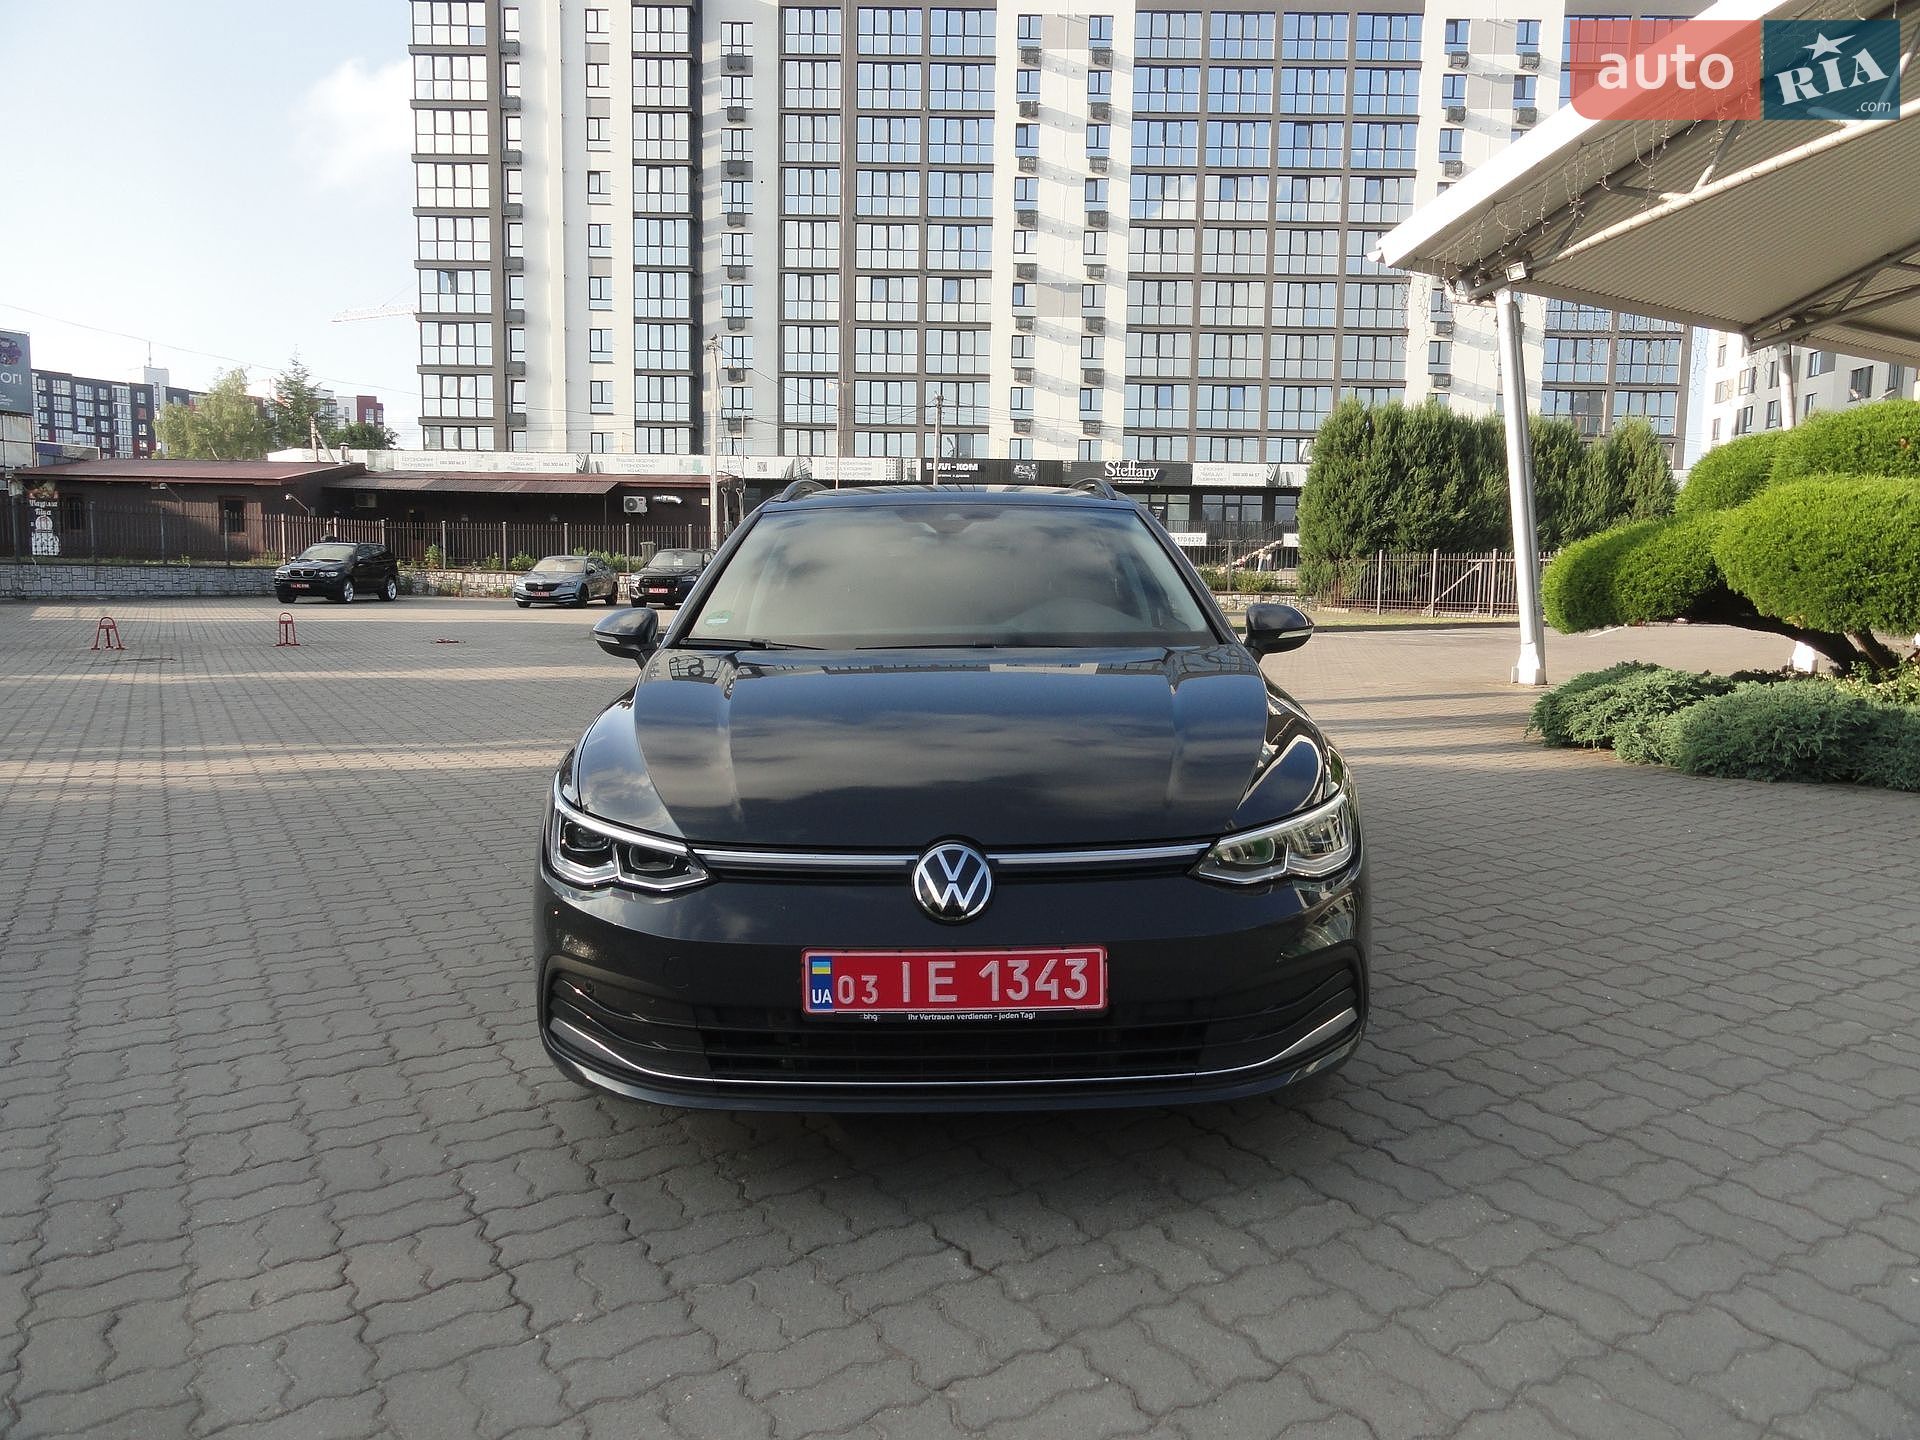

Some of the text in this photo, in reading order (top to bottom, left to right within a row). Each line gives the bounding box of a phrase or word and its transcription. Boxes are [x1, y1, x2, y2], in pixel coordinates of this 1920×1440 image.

[926, 462, 979, 471] ВЛЛ-КОМ
[1104, 459, 1160, 481] Steffany
[837, 958, 1088, 1004] 03 IE 1343
[812, 989, 832, 1004] UA
[863, 1013, 878, 1022] bhg
[908, 1013, 919, 1021] Ihr
[919, 1013, 955, 1021] Vertrauen
[998, 1012, 1019, 1021] jeden
[1019, 1012, 1036, 1020] Tag!
